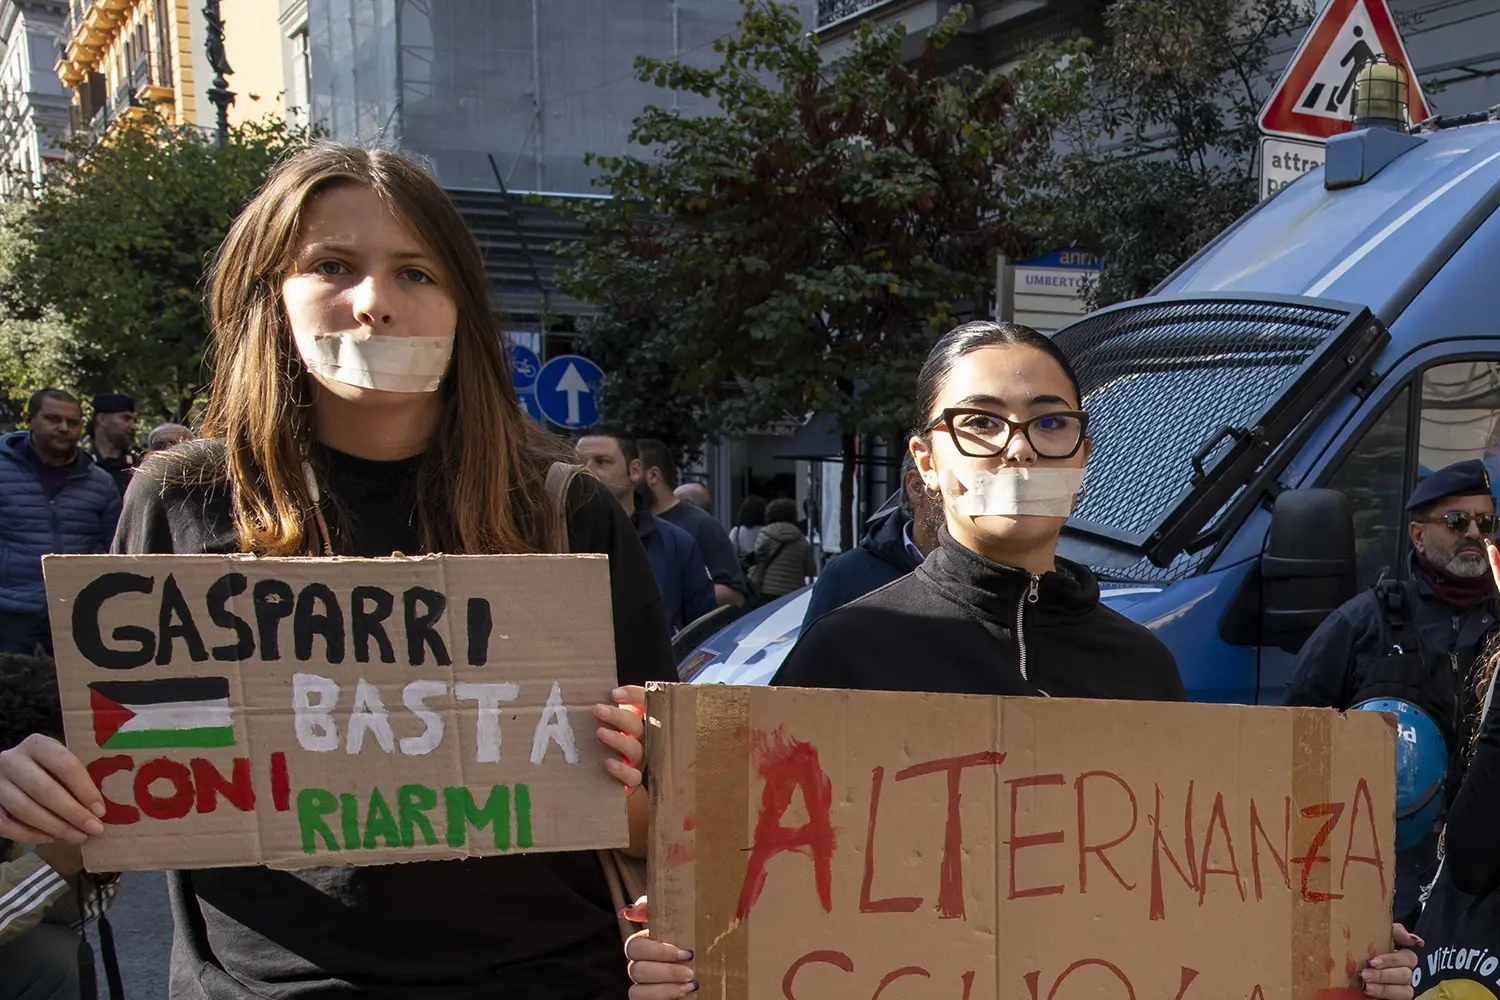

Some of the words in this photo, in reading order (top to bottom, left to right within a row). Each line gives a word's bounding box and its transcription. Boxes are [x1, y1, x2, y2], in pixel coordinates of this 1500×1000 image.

[1271, 151, 1325, 172] attra
[72, 572, 493, 670] GASPARRI
[292, 673, 580, 765] BASTA
[296, 783, 532, 854] RIARMI
[737, 740, 1387, 921] ALTERNANZA
[1427, 945, 1499, 977] Vittorio
